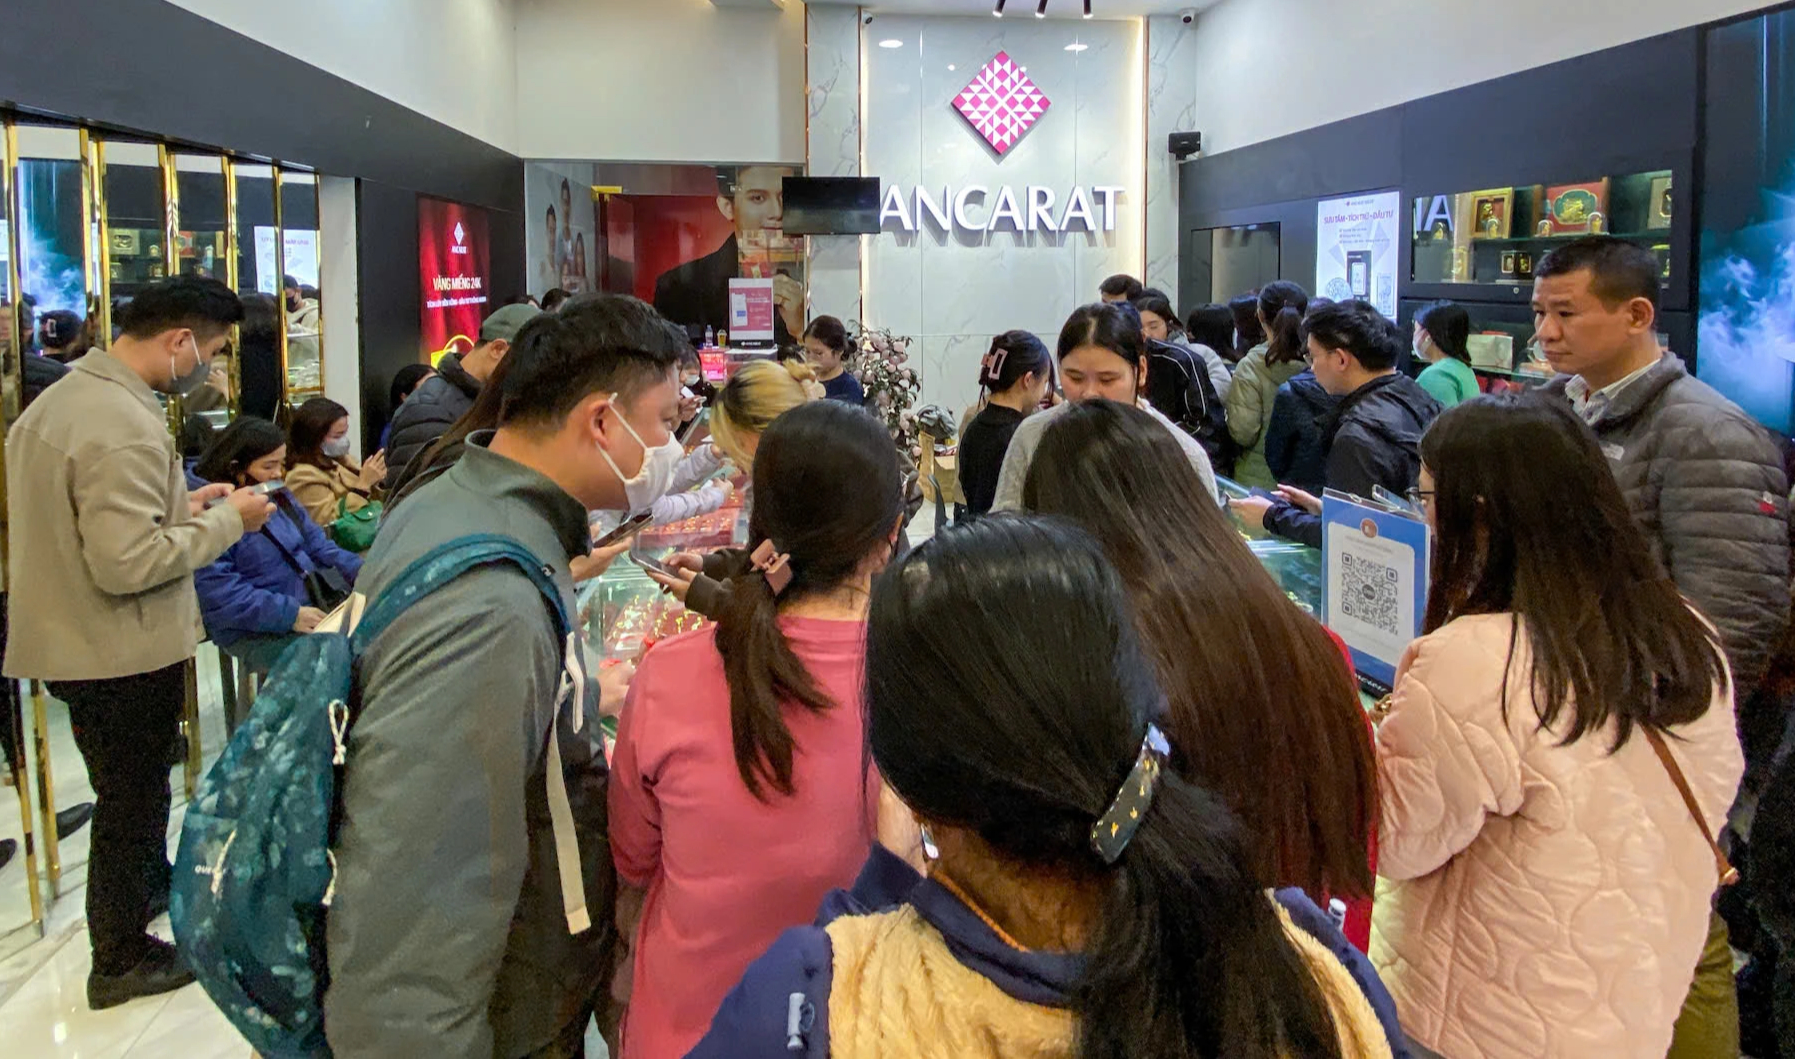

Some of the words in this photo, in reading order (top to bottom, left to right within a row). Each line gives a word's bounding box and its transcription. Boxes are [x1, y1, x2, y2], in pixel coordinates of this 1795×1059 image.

[880, 185, 1125, 231] ANCARAT
[433, 274, 451, 291] VÀNG
[451, 273, 470, 290] MIẾNG
[471, 276, 481, 289] 24K
